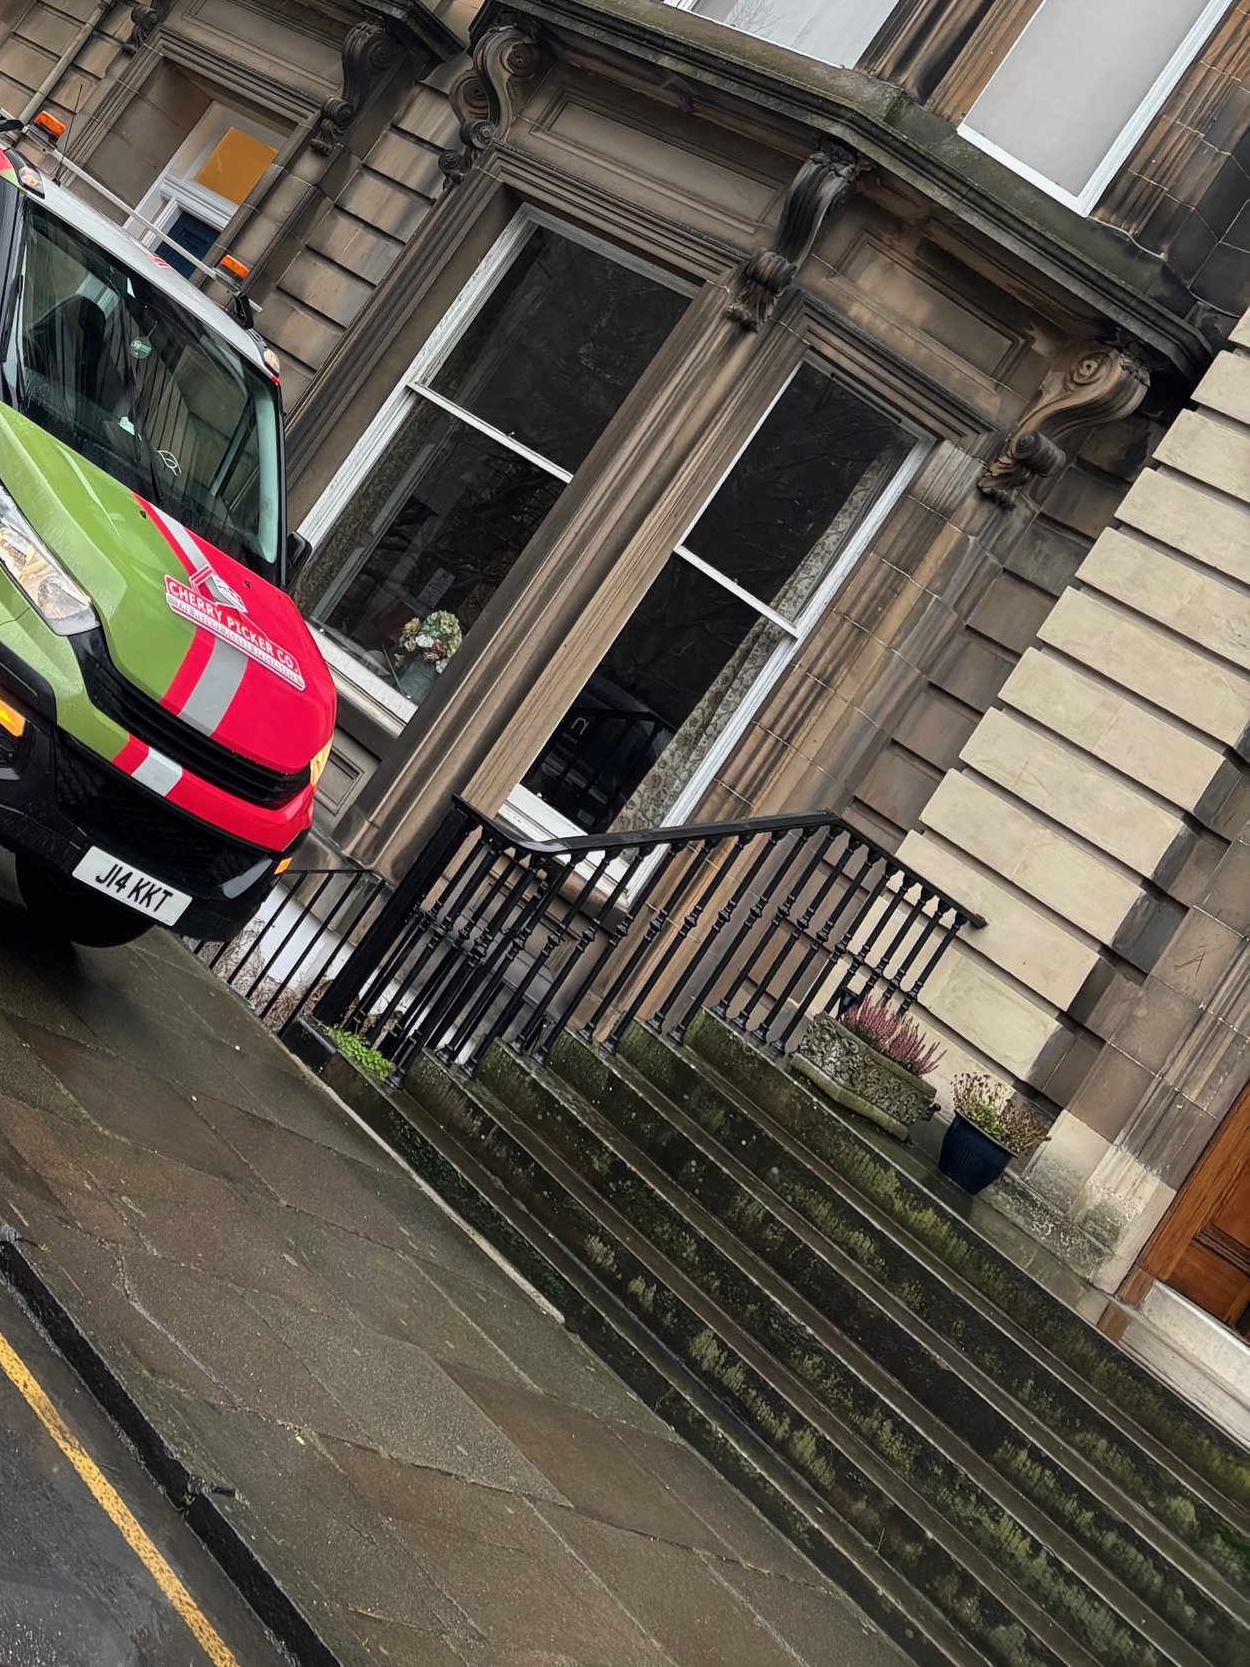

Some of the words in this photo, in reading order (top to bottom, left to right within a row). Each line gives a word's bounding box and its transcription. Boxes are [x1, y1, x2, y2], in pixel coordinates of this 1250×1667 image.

[169, 581, 223, 622] CHERRY
[226, 615, 275, 657] PICKER
[276, 649, 299, 673] CO.
[95, 863, 134, 894] J14
[126, 877, 174, 913] KKT
